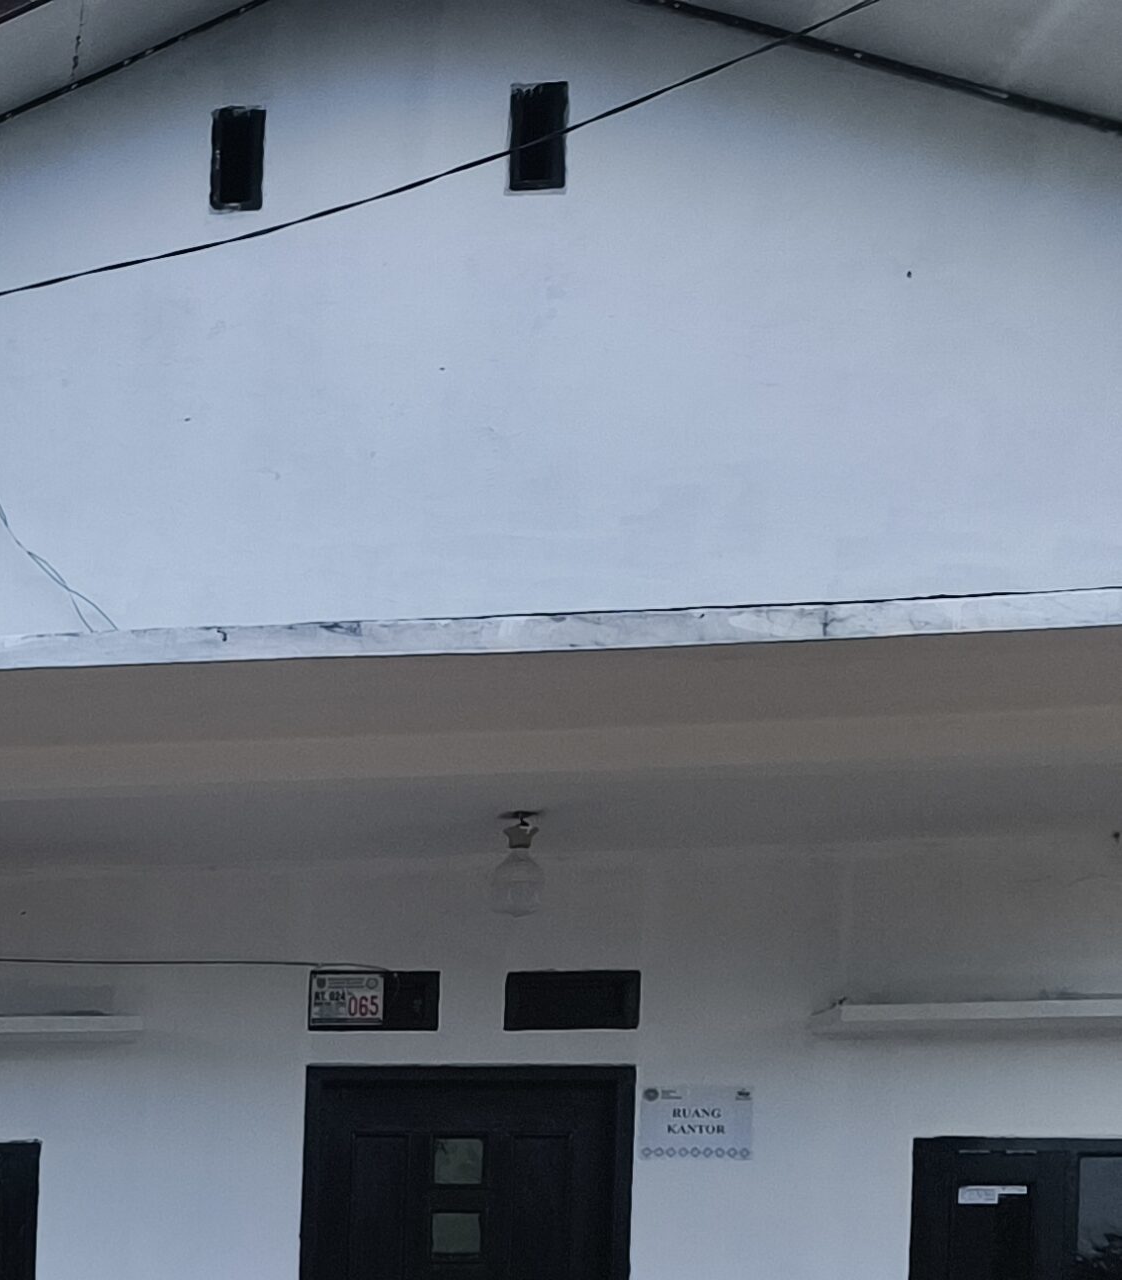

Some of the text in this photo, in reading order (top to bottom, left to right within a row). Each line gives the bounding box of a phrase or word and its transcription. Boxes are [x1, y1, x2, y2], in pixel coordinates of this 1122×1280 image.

[348, 995, 379, 1017] 065
[672, 1108, 722, 1119] RUANG
[667, 1124, 726, 1135] KANTOR
